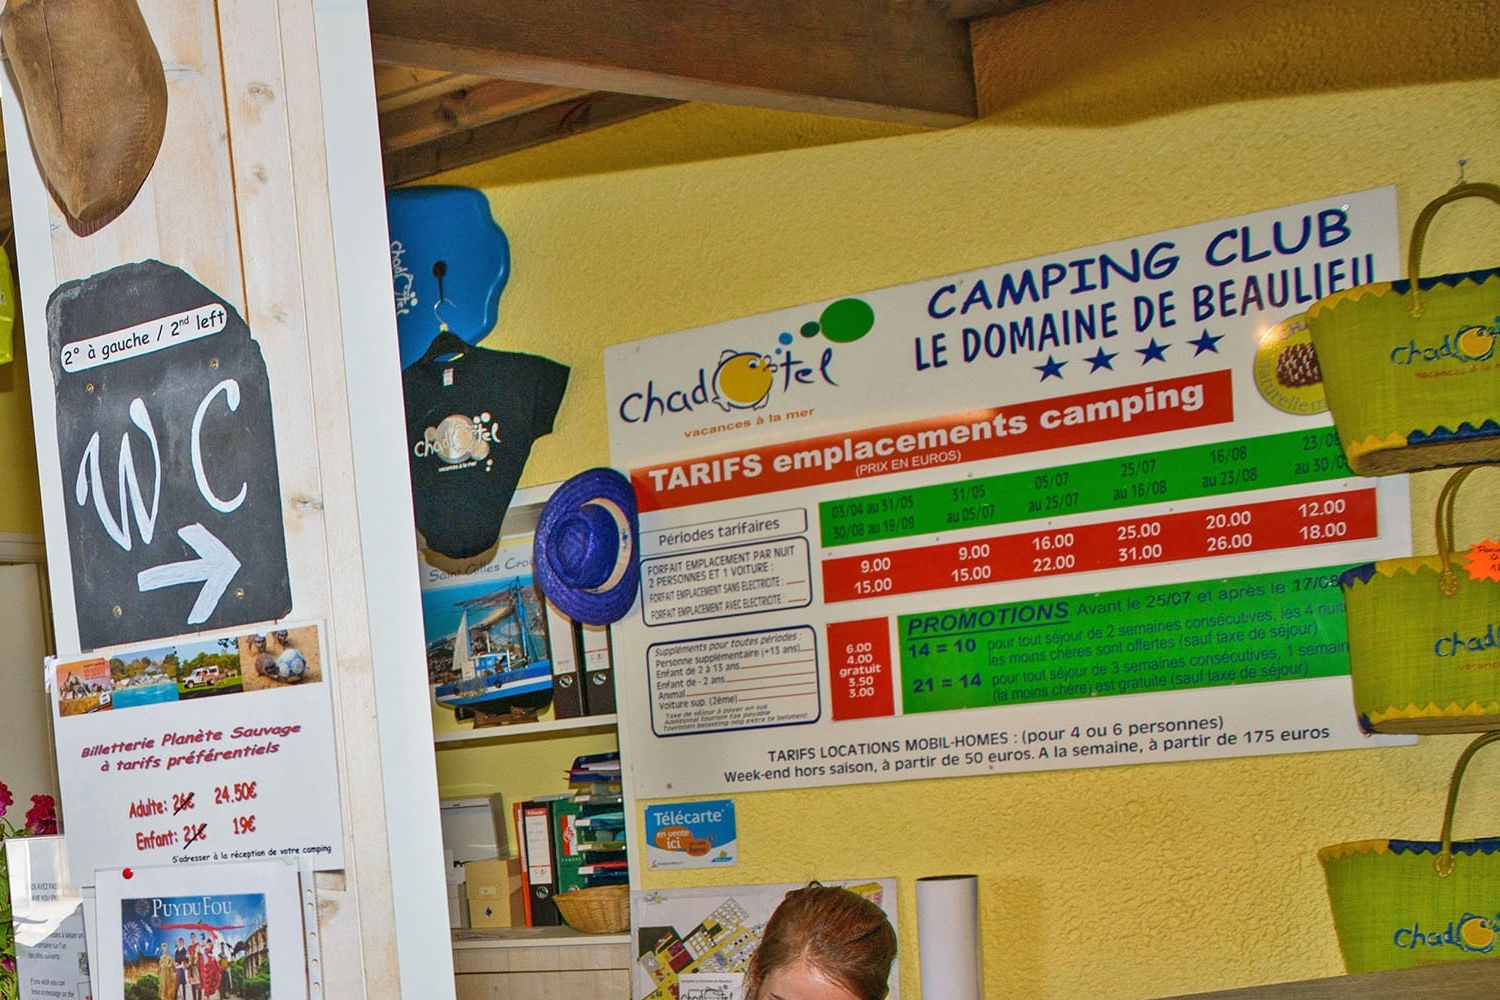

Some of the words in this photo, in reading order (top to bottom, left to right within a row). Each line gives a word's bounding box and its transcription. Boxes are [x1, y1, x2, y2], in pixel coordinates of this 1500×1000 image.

[927, 242, 1180, 319] CAMPING
[1205, 208, 1351, 267] CLUB
[915, 333, 948, 371] LE
[962, 301, 1118, 363] DOMAINE
[1134, 290, 1176, 332] DE
[1192, 253, 1374, 322] BEAULIEU
[88, 344, 96, 359] à
[102, 332, 150, 359] gauche
[171, 316, 189, 337] 2nd
[197, 310, 225, 330] left
[684, 419, 752, 438] vacances
[786, 408, 816, 419] mer
[648, 454, 762, 492] TARIFS
[773, 411, 1028, 473] emplacements
[1041, 383, 1204, 430] camping
[855, 460, 888, 478] (PRIX
[912, 449, 962, 469] EUROS)
[1210, 445, 1247, 464] 16/08
[1121, 460, 1155, 478] 25/07
[1219, 467, 1258, 487] 23/08
[1034, 472, 1069, 490] 05/07
[1131, 480, 1166, 499] 16/08
[1299, 499, 1345, 517] 12.00
[1206, 511, 1251, 529] 20.00
[659, 529, 714, 546] Périodes
[718, 519, 780, 537] tarifaires
[1117, 522, 1161, 540] 25.00
[1300, 523, 1347, 540] 18.00
[1032, 533, 1074, 551] 16.00
[1207, 533, 1252, 551] 26.00
[648, 562, 682, 576] FORFAIT
[686, 552, 750, 571] EMPLACEMENT
[754, 549, 771, 560] PAR
[774, 546, 795, 557] NUIT
[958, 544, 990, 560] 9.00
[1118, 544, 1162, 562] 31.00
[861, 557, 891, 573] 9.00
[1033, 555, 1075, 573] 22.00
[657, 571, 706, 586] PERSONNES
[732, 562, 768, 576] VOITURE
[951, 565, 991, 582] 15.00
[854, 578, 892, 594] 15.00
[908, 602, 1069, 635] PROMOTIONS
[1076, 601, 1122, 616] Avant
[1146, 591, 1190, 609] 25/07
[1218, 581, 1265, 602] après
[1293, 574, 1340, 591] 17/08
[760, 632, 797, 646] périodes
[846, 642, 872, 653] 6.00
[909, 643, 929, 658] 14
[954, 638, 976, 652] 10
[695, 647, 759, 665] supplémentaire
[846, 653, 873, 664] 4.00
[656, 668, 683, 678] Enfant
[839, 664, 881, 678] gratuit
[657, 680, 683, 690] Enfant
[848, 676, 874, 687] 3.50
[913, 678, 933, 693] 21
[960, 673, 981, 687] 14
[659, 691, 685, 700] Animal
[849, 687, 875, 698] 3.00
[81, 738, 154, 758] Billetterie
[161, 729, 222, 746] Planète
[230, 724, 302, 739] Sauvage
[768, 748, 816, 762] TARIFS
[820, 741, 900, 758] LOCATIONS
[905, 731, 1009, 752] MOBIL-HOMES
[1022, 728, 1065, 745] (pour
[1071, 727, 1080, 738] 4
[1086, 725, 1107, 738] ou
[1113, 724, 1122, 735] 6
[1129, 715, 1224, 736] personnes)
[100, 760, 110, 772] à
[116, 755, 160, 771] tarifs
[166, 742, 280, 770] préférentiels
[724, 768, 791, 782] Week-end
[795, 763, 825, 777] hors
[830, 760, 878, 775] saison,
[882, 759, 890, 771] à
[895, 755, 936, 772] partir
[942, 753, 960, 765] de
[965, 751, 983, 764] 50
[988, 749, 1035, 762] euros.
[1038, 748, 1049, 759] A
[1054, 745, 1067, 758] la
[1072, 740, 1144, 756] semaine,
[1149, 739, 1157, 750] à
[1164, 734, 1211, 752] partir
[1217, 733, 1237, 745] de
[1243, 730, 1275, 744] 175
[1281, 727, 1330, 741] euros
[129, 800, 168, 818] Adulte:
[214, 781, 258, 804] 24.50€
[653, 810, 722, 826] Télécarte
[136, 830, 178, 850] Enfant:
[232, 815, 256, 834] 19€
[221, 850, 228, 859] la
[230, 848, 266, 860] réception
[268, 847, 277, 856] de
[280, 846, 300, 854] votre
[302, 844, 332, 855] camping
[667, 837, 680, 849] ici
